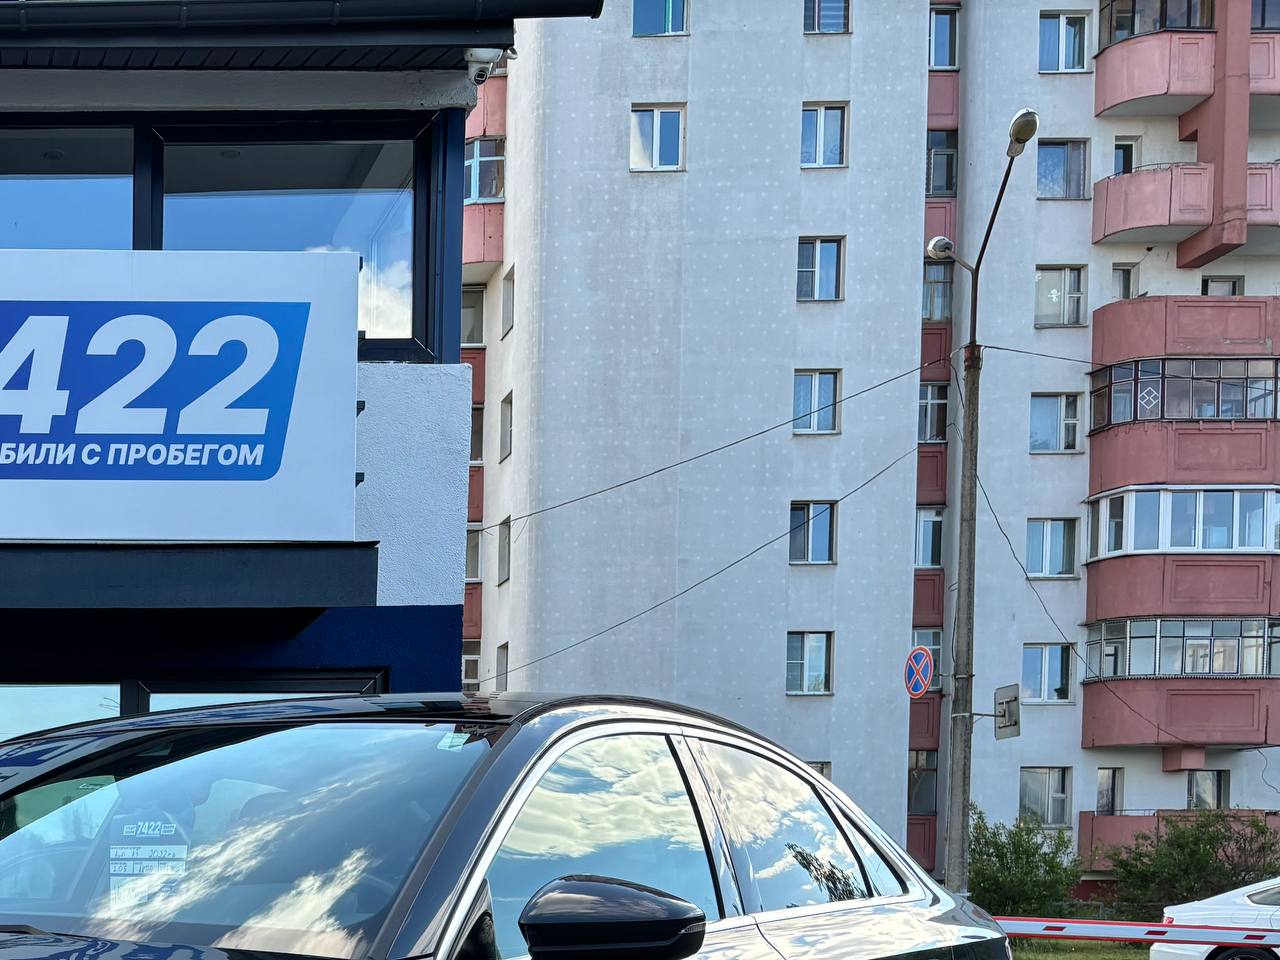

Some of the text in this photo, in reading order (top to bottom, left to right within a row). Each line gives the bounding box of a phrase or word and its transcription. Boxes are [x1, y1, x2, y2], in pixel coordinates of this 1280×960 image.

[81, 443, 101, 466] С
[105, 444, 264, 467] ПРОБЕГОМ
[136, 822, 161, 834] 7422
